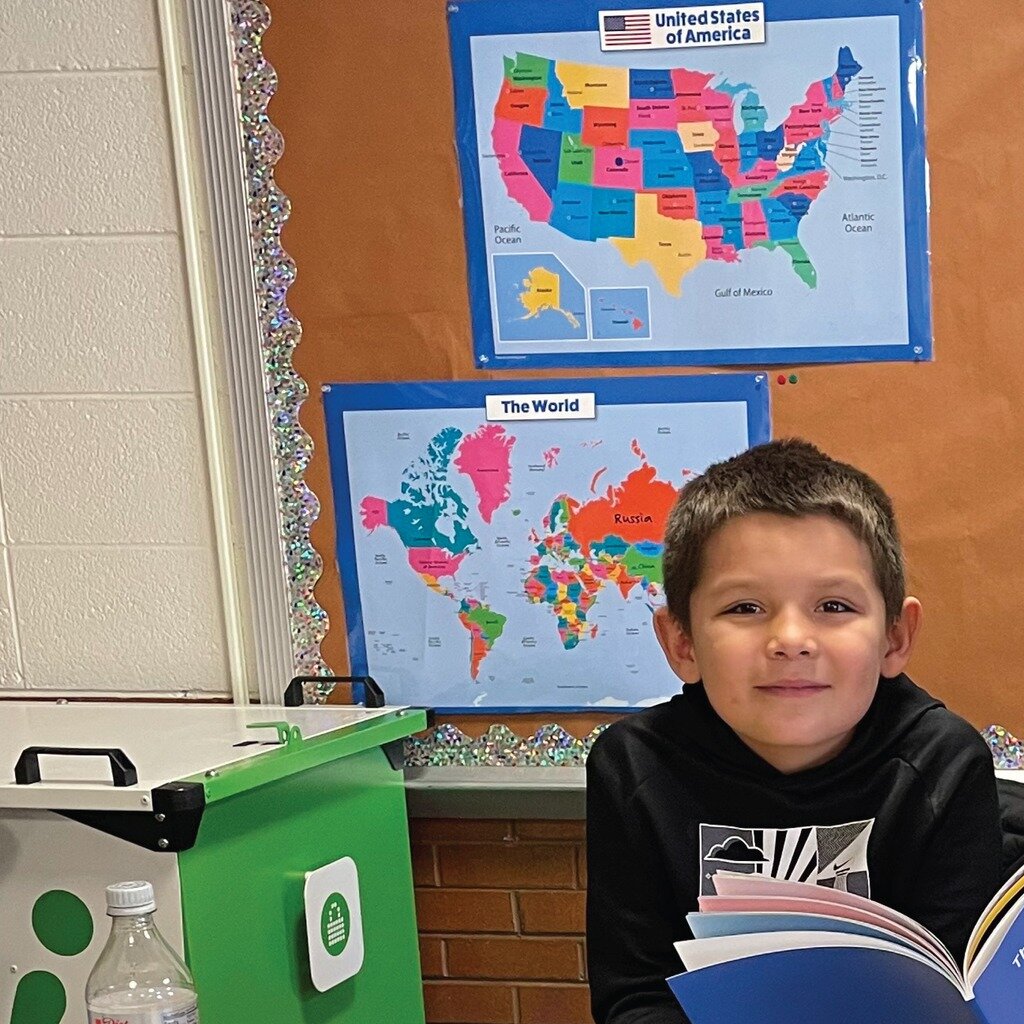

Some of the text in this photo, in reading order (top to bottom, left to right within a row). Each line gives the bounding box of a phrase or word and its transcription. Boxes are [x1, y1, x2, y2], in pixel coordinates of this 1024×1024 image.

[655, 9, 760, 27] United States
[666, 26, 751, 44] of America
[841, 212, 875, 222] Atlantic
[494, 224, 521, 234] Pacific
[844, 224, 873, 233] Ocean
[494, 236, 522, 245] Ocean
[714, 287, 773, 298] Gulf of Mexico
[501, 398, 579, 414] The World
[614, 512, 653, 524] Russia
